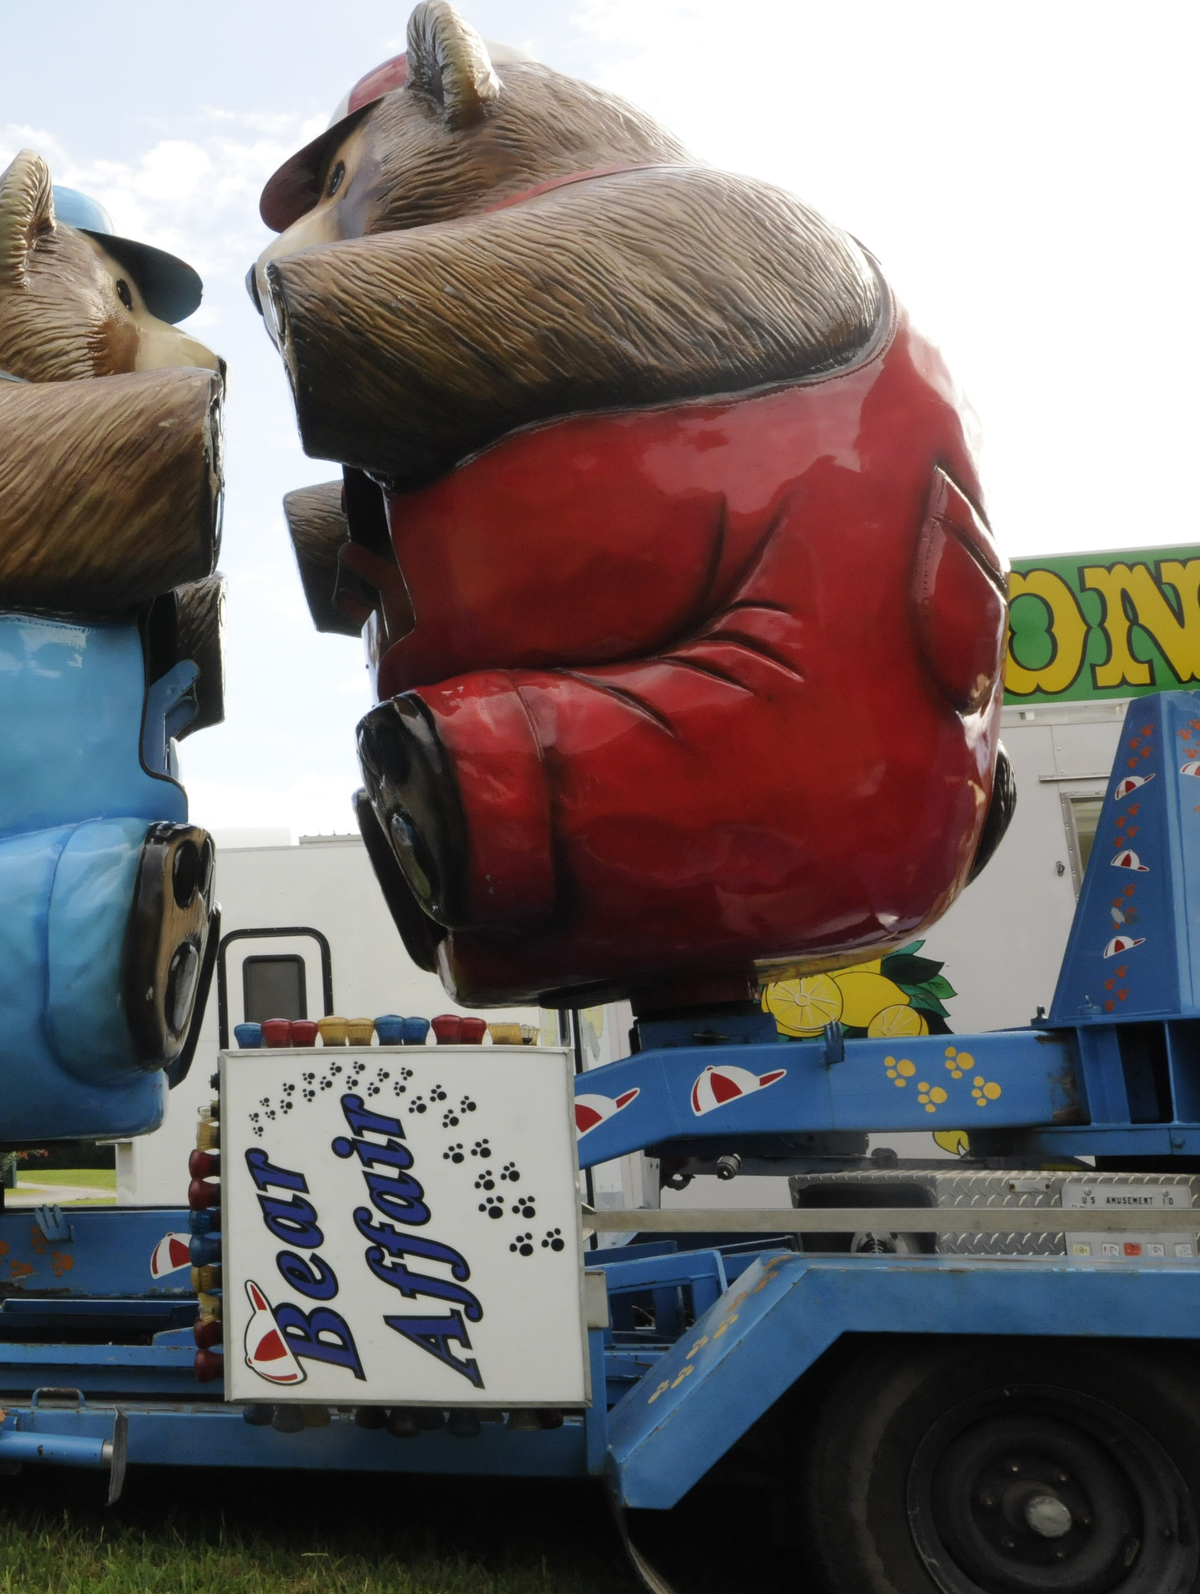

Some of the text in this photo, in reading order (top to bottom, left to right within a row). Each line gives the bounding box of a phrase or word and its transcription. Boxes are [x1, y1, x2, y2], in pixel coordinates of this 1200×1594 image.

[245, 1147, 367, 1382] Bear
[331, 1093, 486, 1390] Affair
[1106, 1196, 1153, 1206] AMUSEMENT
